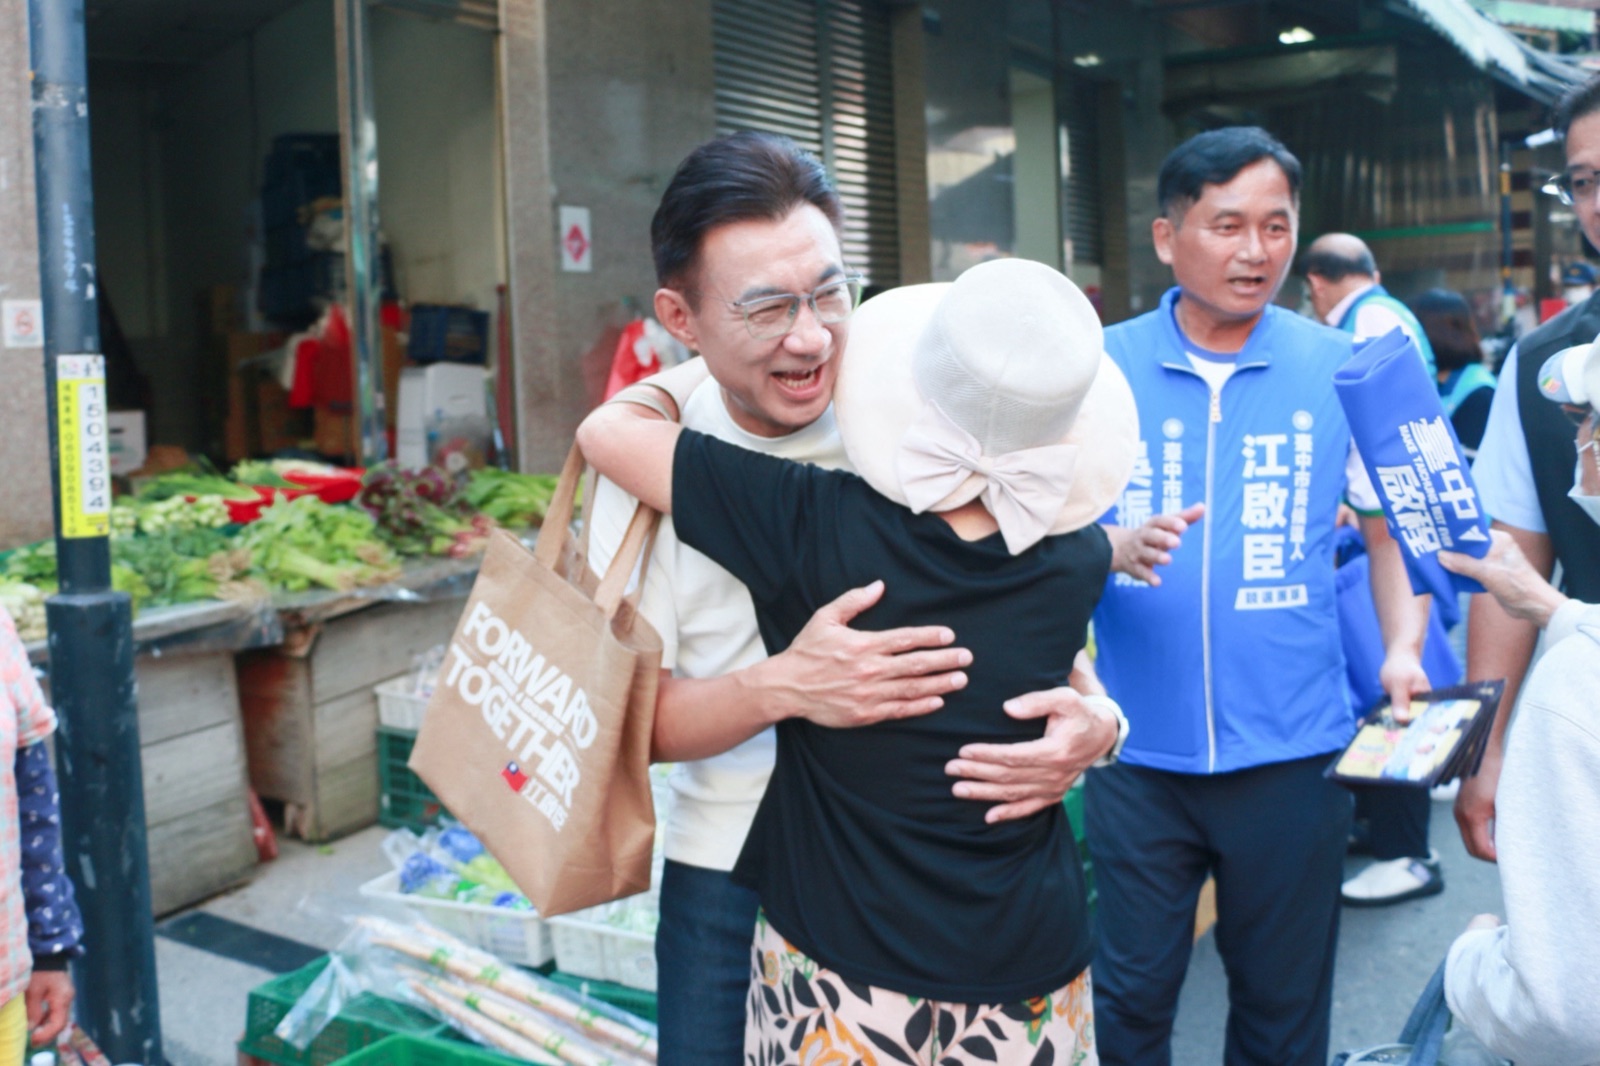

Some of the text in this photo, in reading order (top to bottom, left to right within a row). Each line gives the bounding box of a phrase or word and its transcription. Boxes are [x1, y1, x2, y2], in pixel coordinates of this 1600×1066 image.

[86, 386, 104, 507] 1504394
[1398, 424, 1414, 454] MAKE
[1413, 454, 1439, 504] TAICHUNG
[1409, 415, 1479, 519] 臺中
[1240, 434, 1290, 581] 江啟臣
[1375, 465, 1442, 559] 啟程
[446, 643, 580, 808] TOGETHER
[463, 601, 598, 749] FORWARD
